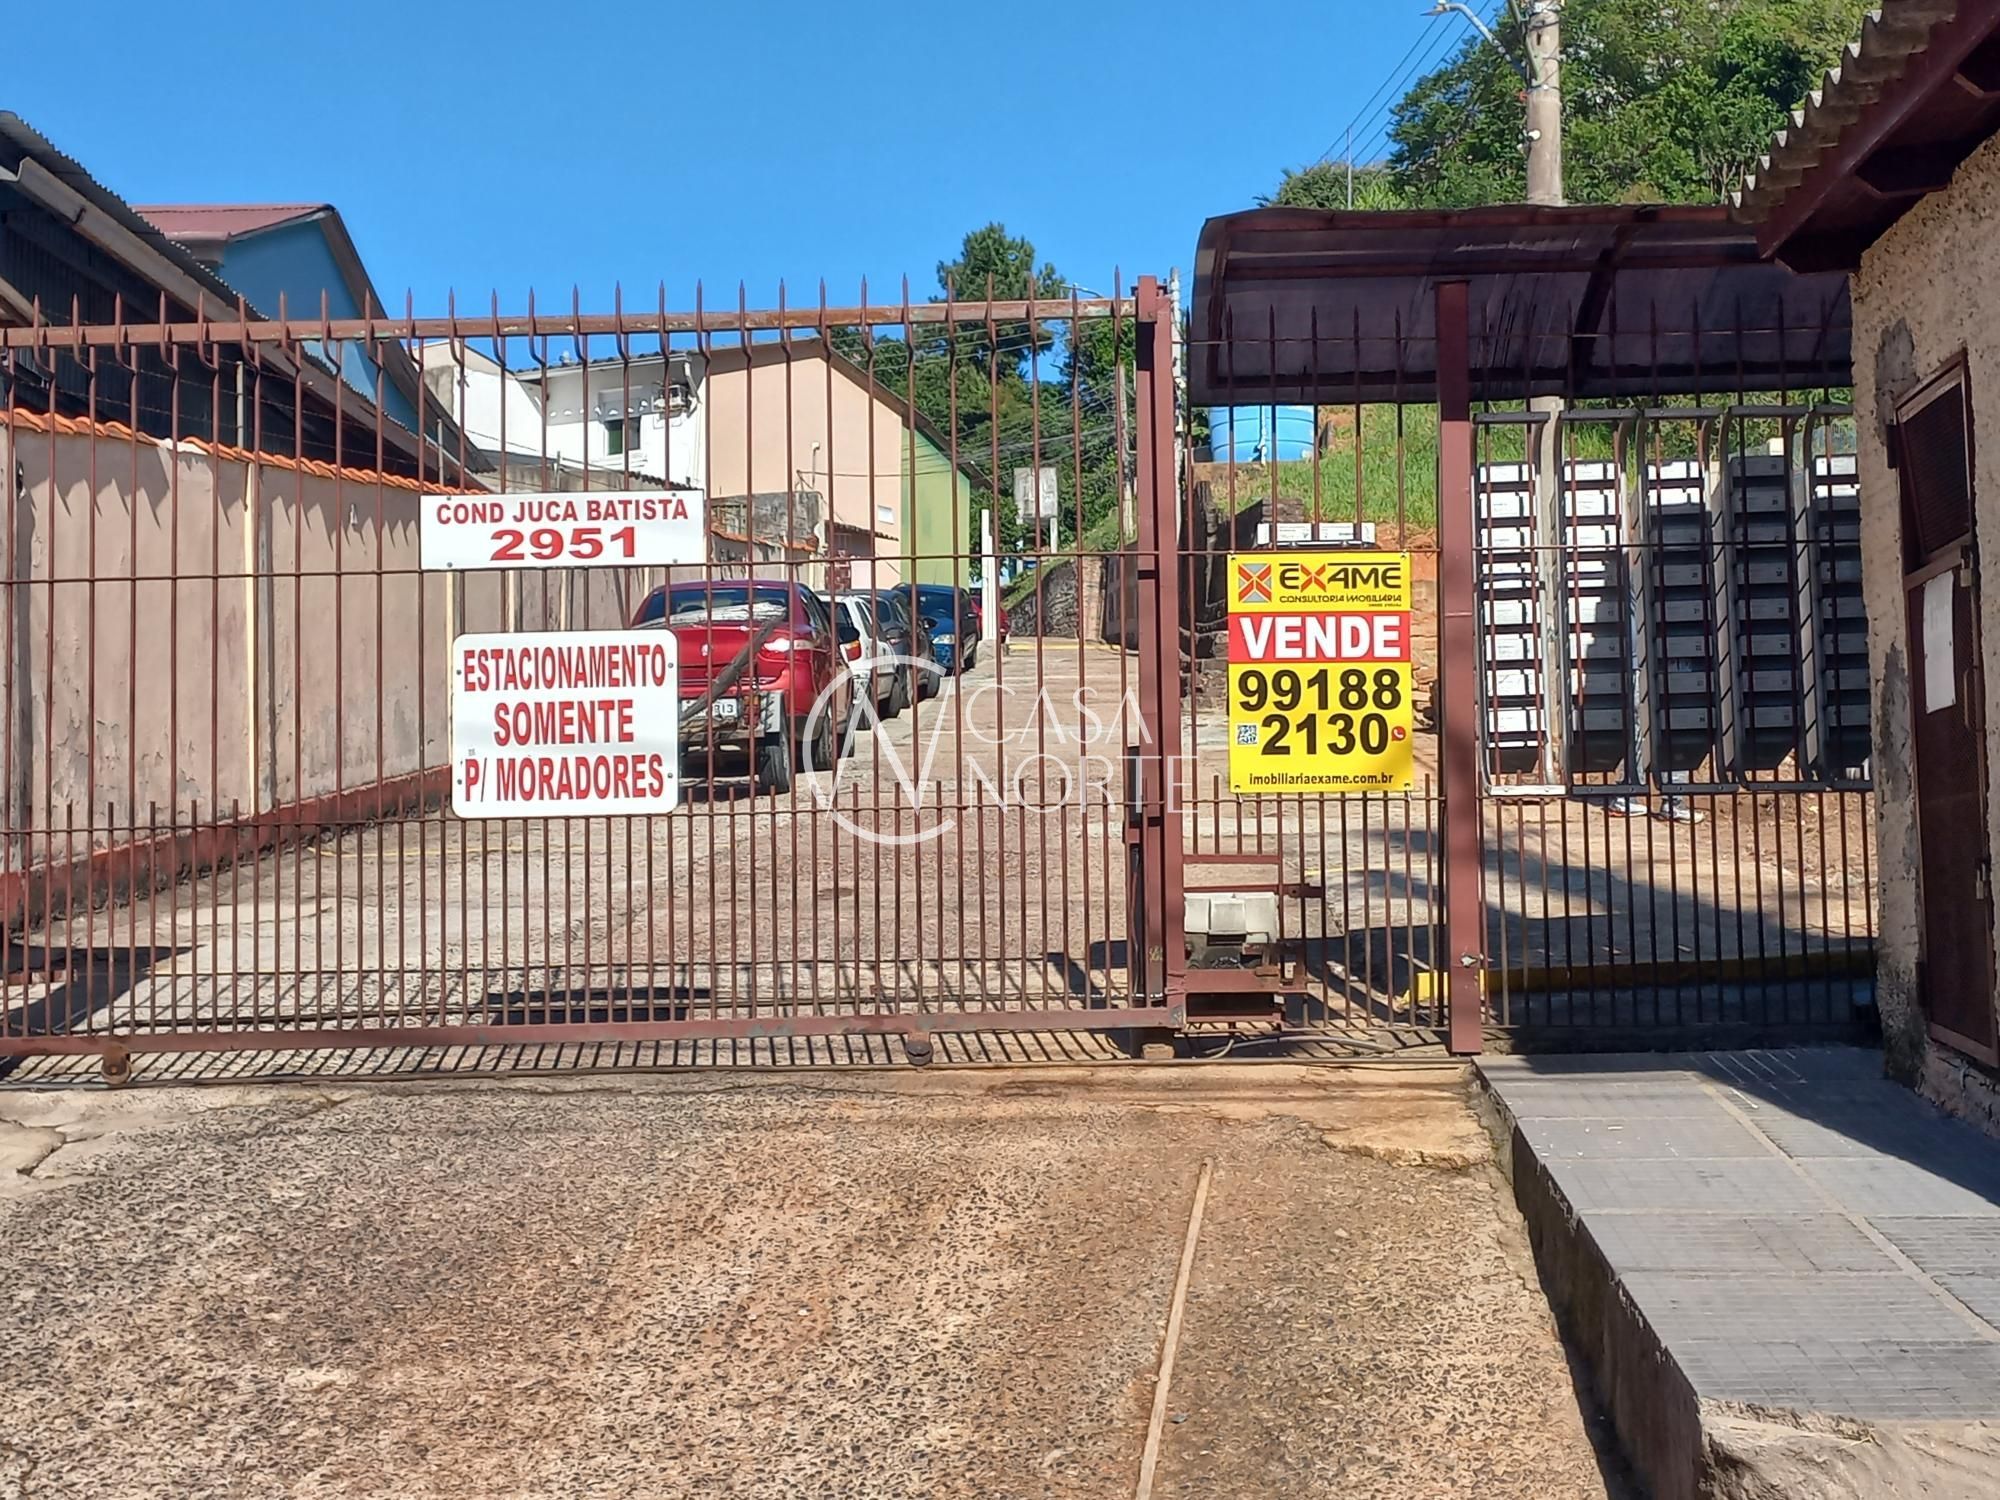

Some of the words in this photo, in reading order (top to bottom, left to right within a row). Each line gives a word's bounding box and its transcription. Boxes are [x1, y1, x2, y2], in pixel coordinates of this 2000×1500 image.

[436, 502, 504, 525] COND
[512, 500, 579, 523] JUCA
[586, 498, 689, 521] BATISTA
[490, 526, 635, 561] 2951
[1279, 562, 1401, 593] EXAME
[1279, 595, 1345, 603] CONSULTORIA
[1239, 615, 1401, 659] VENDE
[463, 644, 666, 692] ESTACIONAMENTO
[1238, 668, 1401, 712] 99188
[494, 699, 634, 747] SOMENTE
[1261, 713, 1389, 756] 2130
[465, 758, 487, 803] P/
[496, 752, 664, 802] MORADORES
